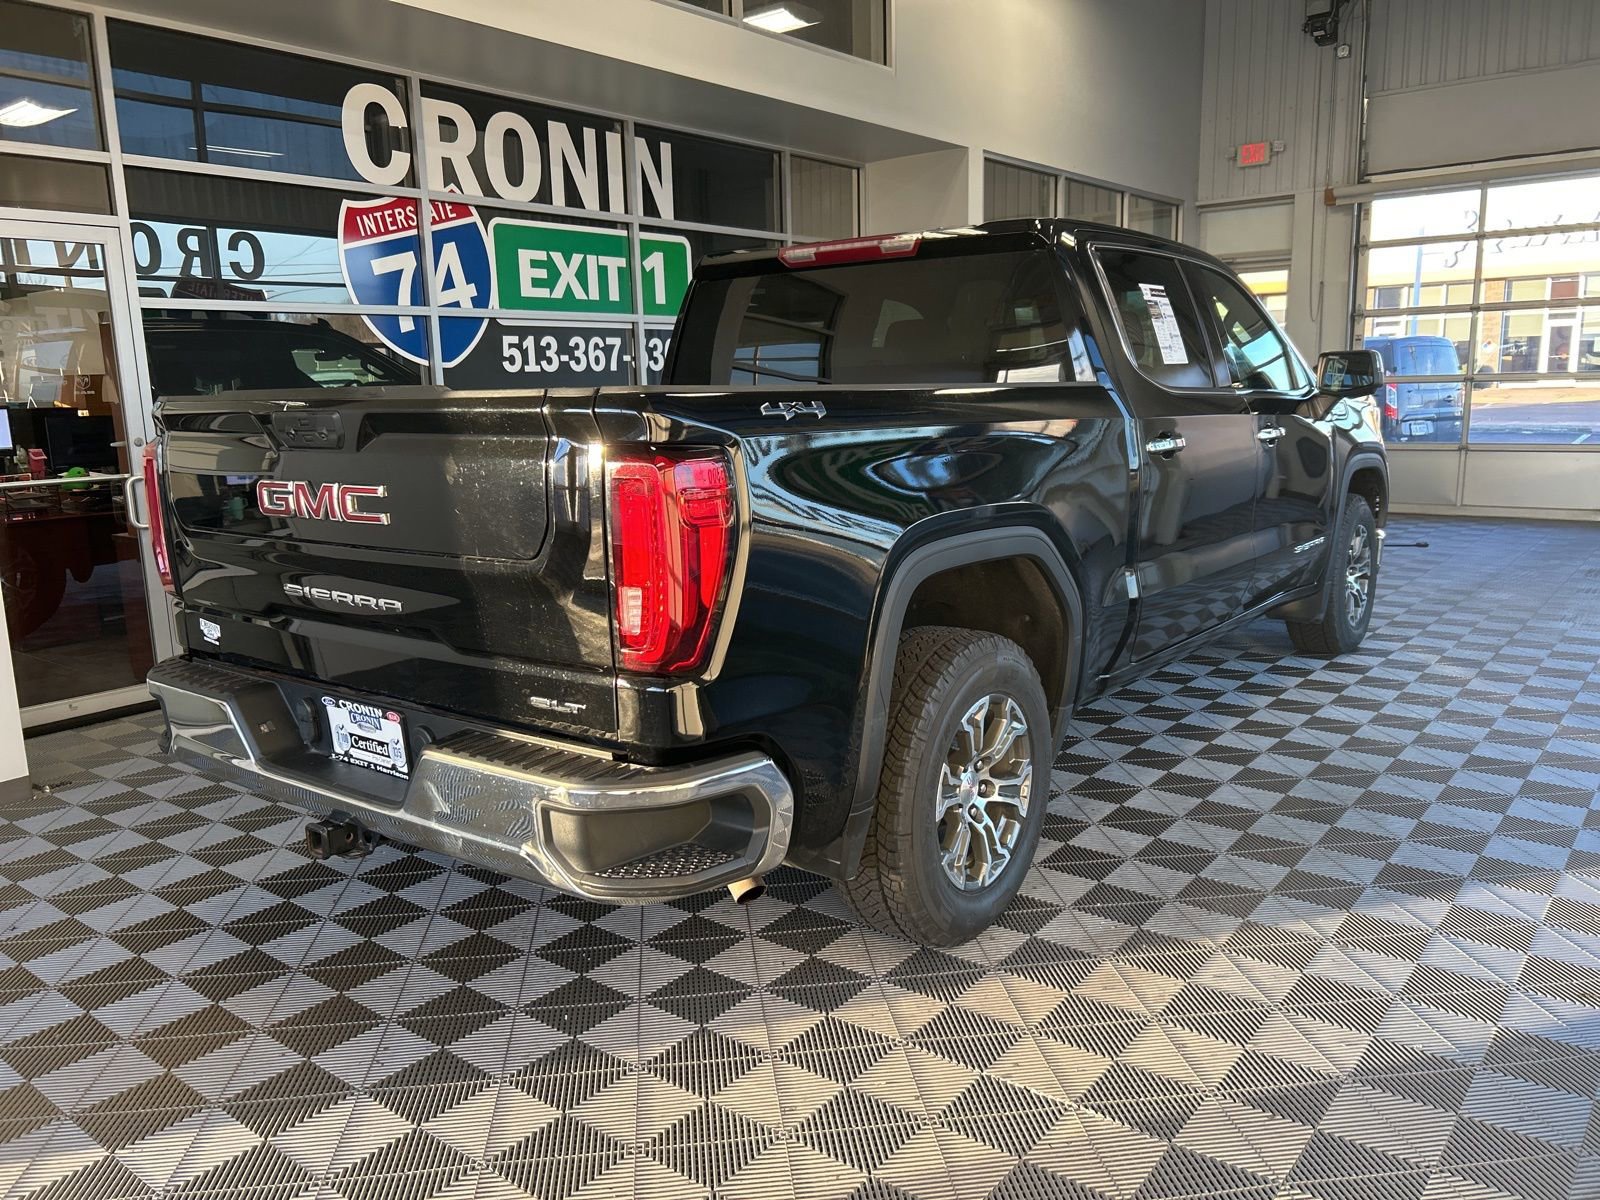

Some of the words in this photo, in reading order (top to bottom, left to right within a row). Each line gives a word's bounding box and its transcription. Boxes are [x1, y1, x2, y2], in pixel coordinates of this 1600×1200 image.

[341, 82, 675, 220] CRONIN
[356, 201, 457, 237] INTERSATE
[370, 241, 478, 333] 74
[517, 248, 627, 302] EXIT
[641, 251, 667, 305] 1
[256, 480, 391, 525] GMC
[283, 582, 403, 613] SIERRA
[338, 699, 383, 718] CRONIN
[529, 696, 587, 714] SLT
[351, 735, 389, 756] Certified
[349, 758, 369, 768] EXIT
[376, 765, 409, 780] Harrison
